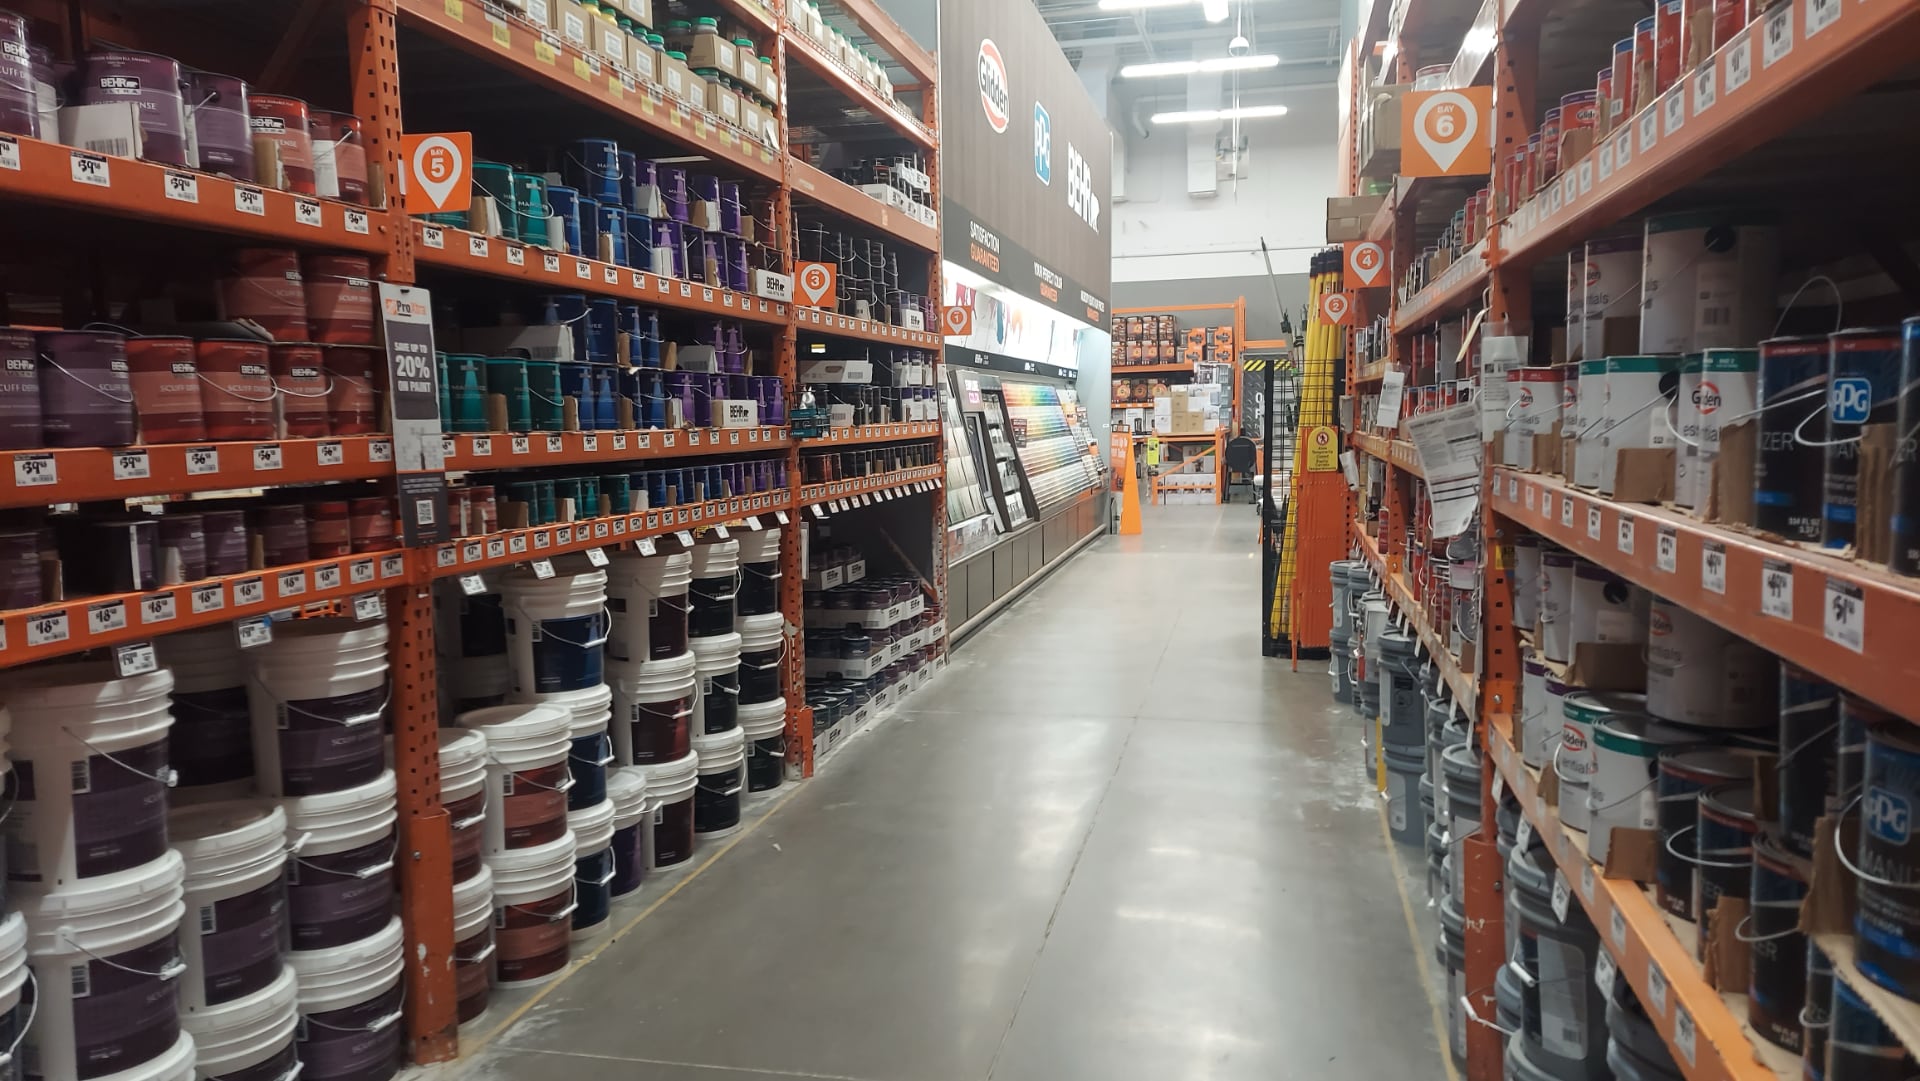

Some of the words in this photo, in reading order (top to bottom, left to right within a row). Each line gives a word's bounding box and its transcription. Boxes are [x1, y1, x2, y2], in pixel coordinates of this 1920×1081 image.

[100, 77, 127, 89] BEHR
[979, 54, 1009, 120] Glidden
[1437, 105, 1455, 113] BAY
[1436, 114, 1455, 138] 6
[1035, 114, 1051, 172] PPG
[430, 148, 444, 156] BAY
[430, 157, 445, 178] 5
[1068, 142, 1093, 226] BEHR
[969, 220, 1000, 255] SATISFACTION
[970, 242, 1000, 273] GUARANTEED
[1362, 254, 1373, 266] 4
[767, 276, 780, 292] BEHR
[810, 275, 821, 287] 3
[1332, 302, 1340, 311] 2
[410, 343, 419, 353] UP
[419, 344, 428, 354] TO
[7, 359, 29, 369] BEHR
[241, 365, 260, 375] BEHR
[395, 354, 431, 379] 20%
[1834, 383, 1868, 418] PPG
